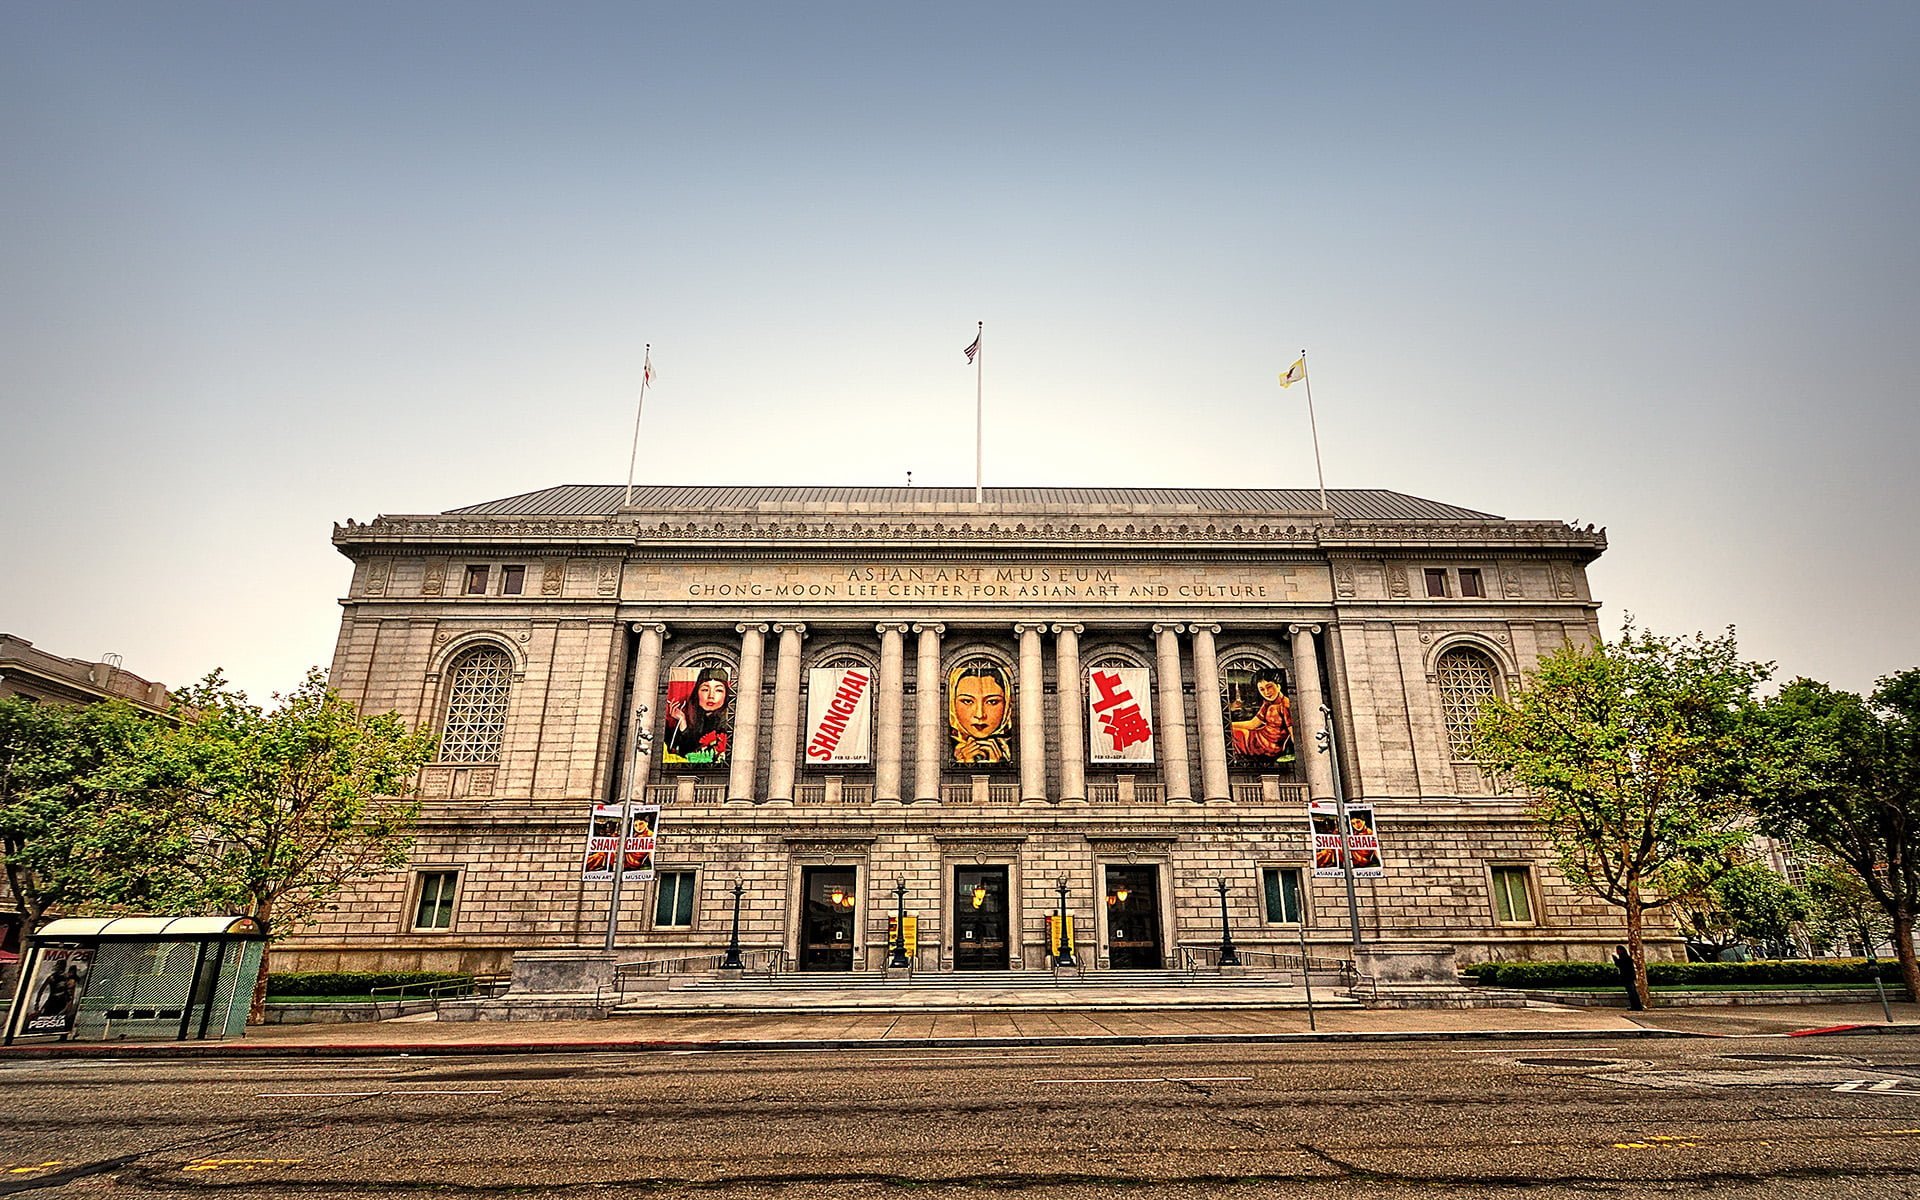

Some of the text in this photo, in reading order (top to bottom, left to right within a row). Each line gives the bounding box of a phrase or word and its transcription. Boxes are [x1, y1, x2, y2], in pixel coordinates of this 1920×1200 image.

[848, 568, 1113, 582] ASIAN ART MUSEUM
[689, 584, 1267, 598] CHONG-MOON LEE CENTER FOR ASIAN ART AND CULTURE
[807, 669, 869, 761] SHANGHAI
[1091, 670, 1153, 753] 上海
[45, 950, 71, 961] MAY
